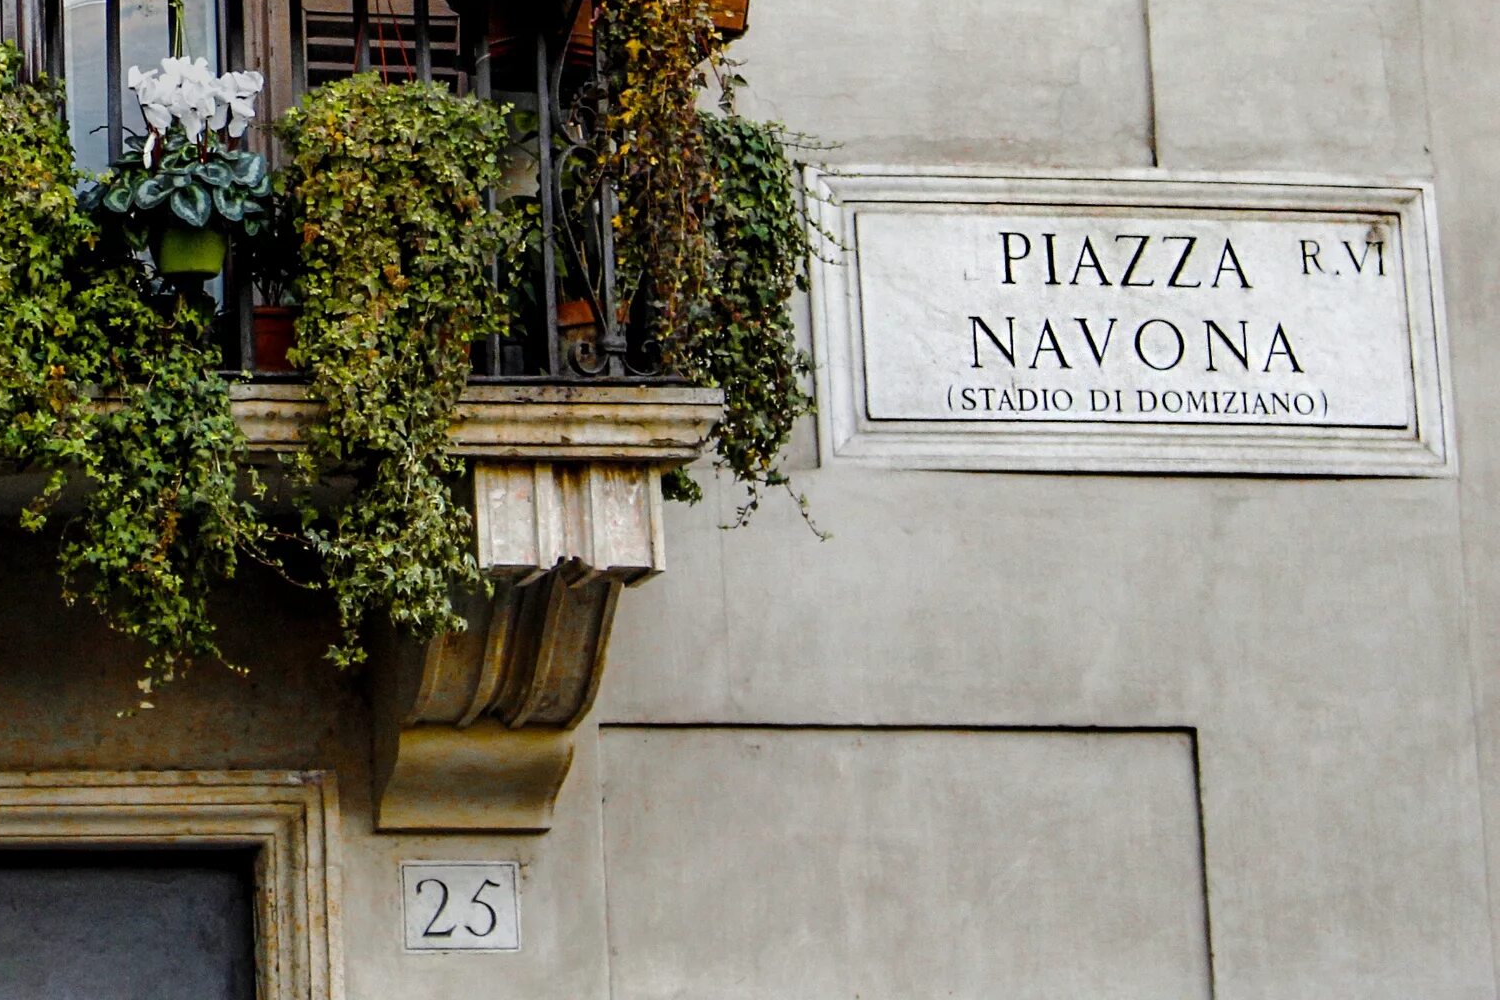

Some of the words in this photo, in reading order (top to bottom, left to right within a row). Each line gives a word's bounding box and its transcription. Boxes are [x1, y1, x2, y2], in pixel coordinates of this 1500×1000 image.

[998, 231, 1254, 289] PIAZZA
[967, 315, 1305, 374] NAVONA
[946, 384, 1074, 413] (STADIO
[1089, 389, 1123, 413] DI
[1136, 388, 1329, 418] DOMIZIANO)
[415, 878, 501, 938] 25
